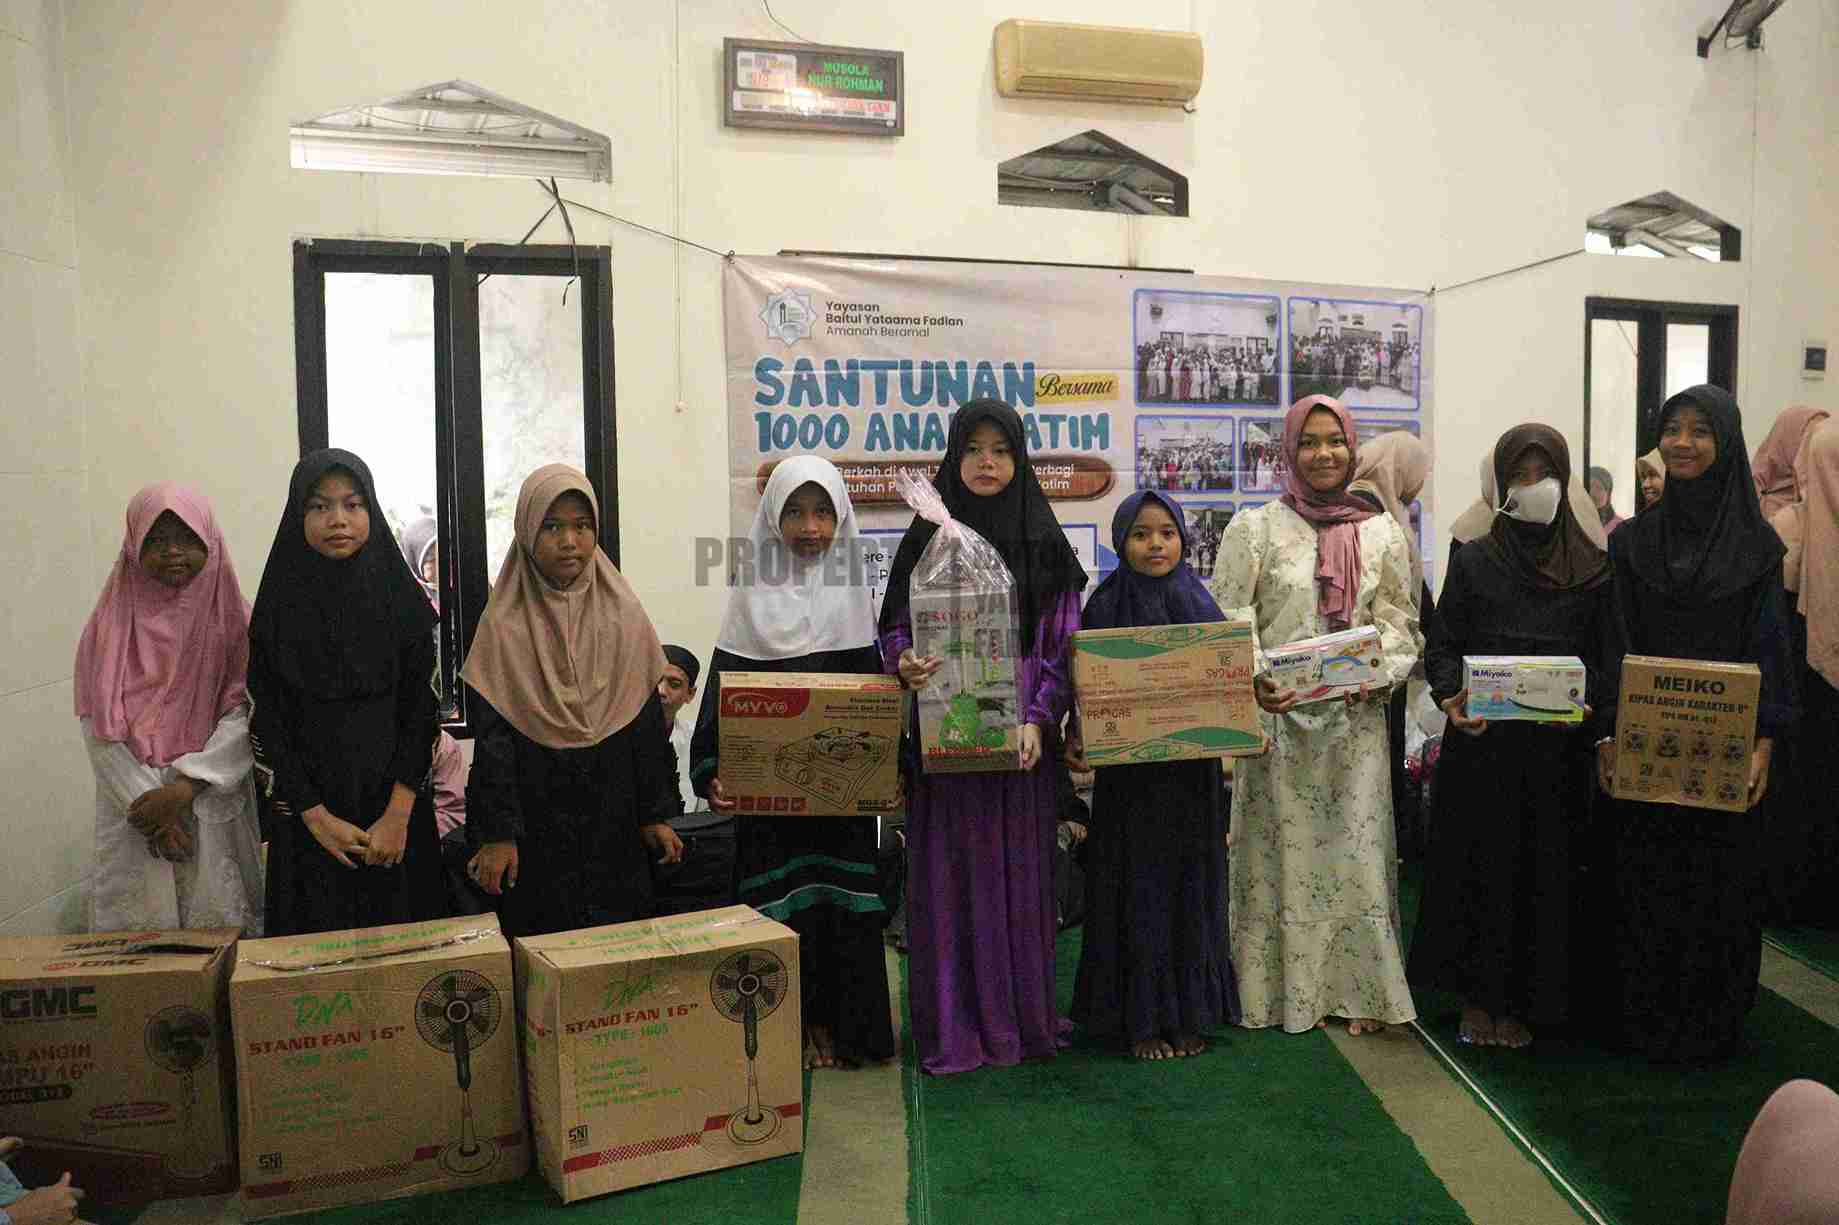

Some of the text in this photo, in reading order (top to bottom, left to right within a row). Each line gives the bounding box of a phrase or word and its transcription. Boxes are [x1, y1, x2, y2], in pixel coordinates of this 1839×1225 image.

[825, 302, 880, 315] Yayasan
[826, 313, 861, 324] Baitul
[864, 315, 921, 325] Yataama
[826, 326, 930, 337] Amanah Beramal
[754, 358, 1113, 408] SANTUNAN Bersama
[755, 412, 1110, 452] 1000 ANA ATIM
[1032, 464, 1074, 478] erbagi
[847, 482, 885, 492] tuhan
[1039, 480, 1069, 489] atim
[1281, 656, 1311, 665] Miyako
[1480, 669, 1512, 679] Miyako
[1654, 675, 1725, 695] MEIKO
[0, 985, 97, 1018] GMC
[565, 1003, 699, 1034] STAND FAN 16"
[249, 1026, 405, 1057] STAND FAN 16"
[28, 1043, 92, 1062] ANGIN
